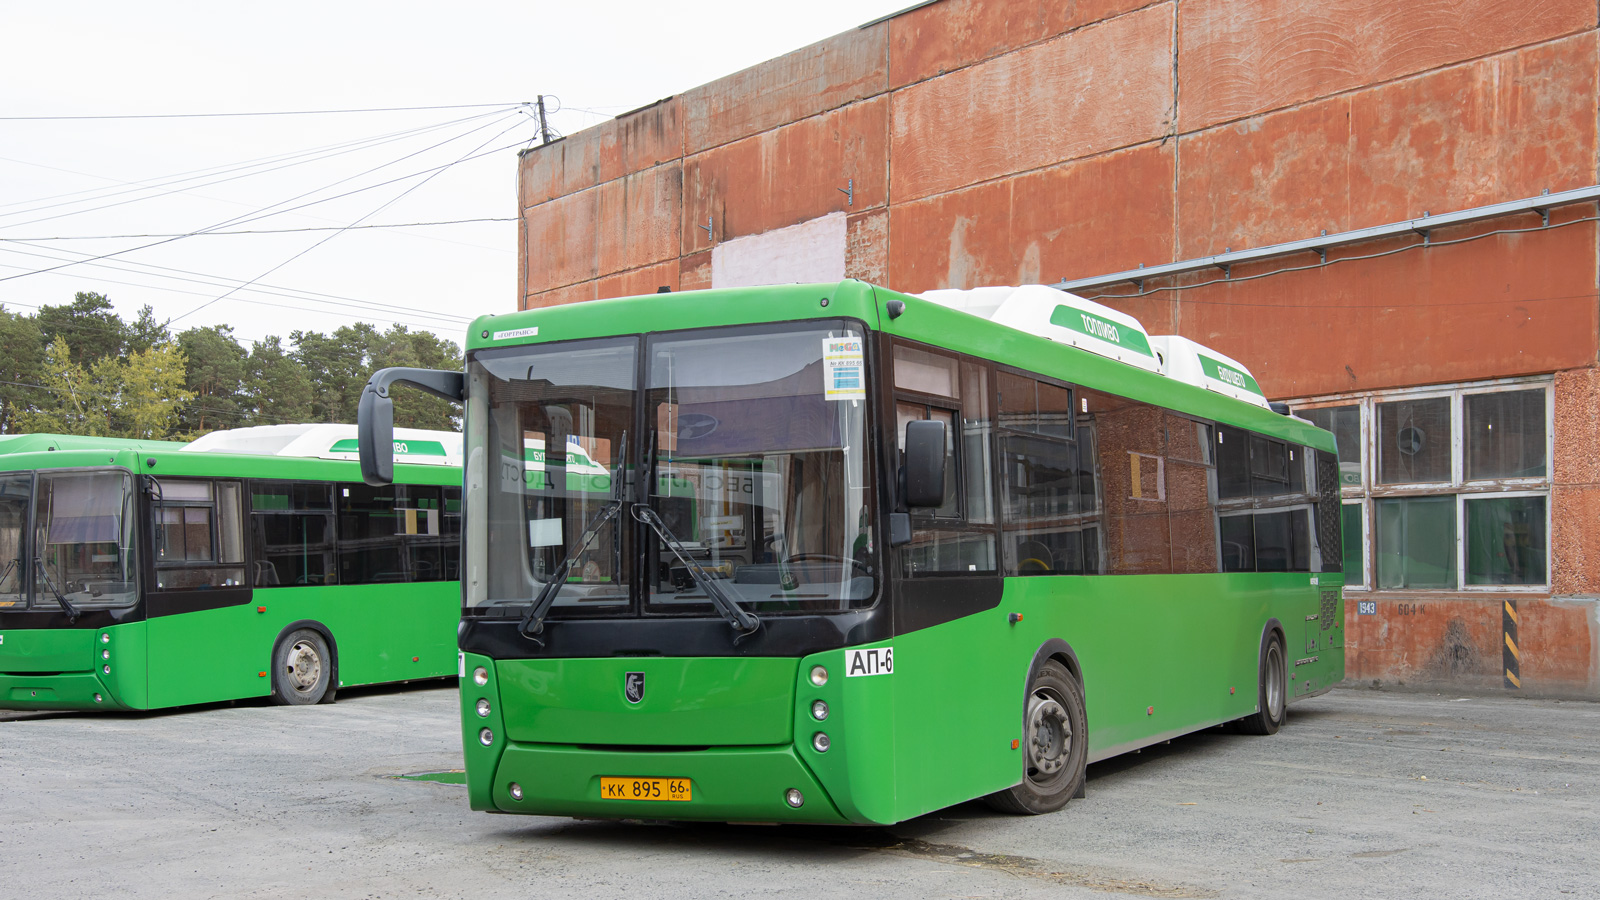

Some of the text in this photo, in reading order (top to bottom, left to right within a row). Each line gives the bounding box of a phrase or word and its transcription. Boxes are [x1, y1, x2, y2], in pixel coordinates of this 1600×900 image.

[1081, 314, 1120, 343] ТОПЛИВО
[1217, 366, 1246, 388] БУДУЩЕГО
[1398, 603, 1416, 616] 604
[850, 649, 892, 675] АП-6
[633, 781, 660, 797] 895
[670, 781, 685, 793] 66
